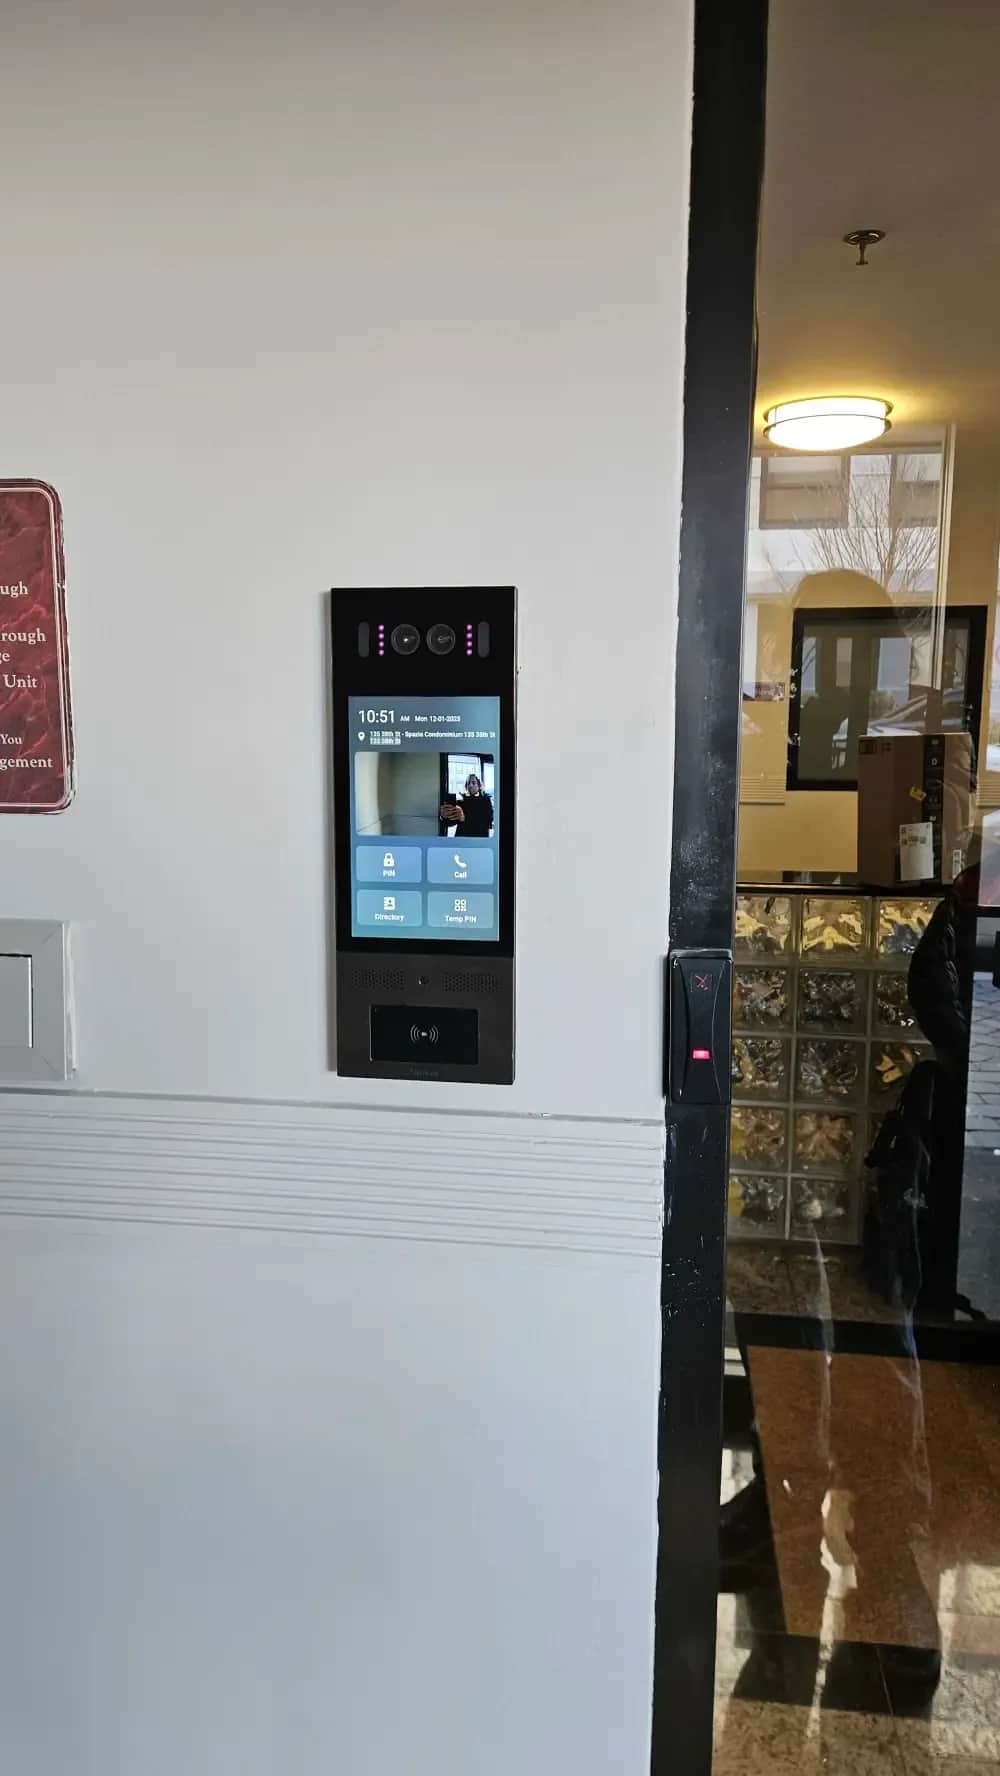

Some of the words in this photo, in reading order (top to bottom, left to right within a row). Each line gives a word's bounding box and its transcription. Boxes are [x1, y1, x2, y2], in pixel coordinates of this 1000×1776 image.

[3, 674, 38, 688] Unit
[358, 710, 395, 723] 10:51
[0, 734, 23, 745] You
[383, 870, 396, 878] PIN
[454, 871, 467, 879] Call
[374, 913, 405, 922] Directory
[445, 915, 463, 924] Temp
[464, 916, 477, 924] PIN
